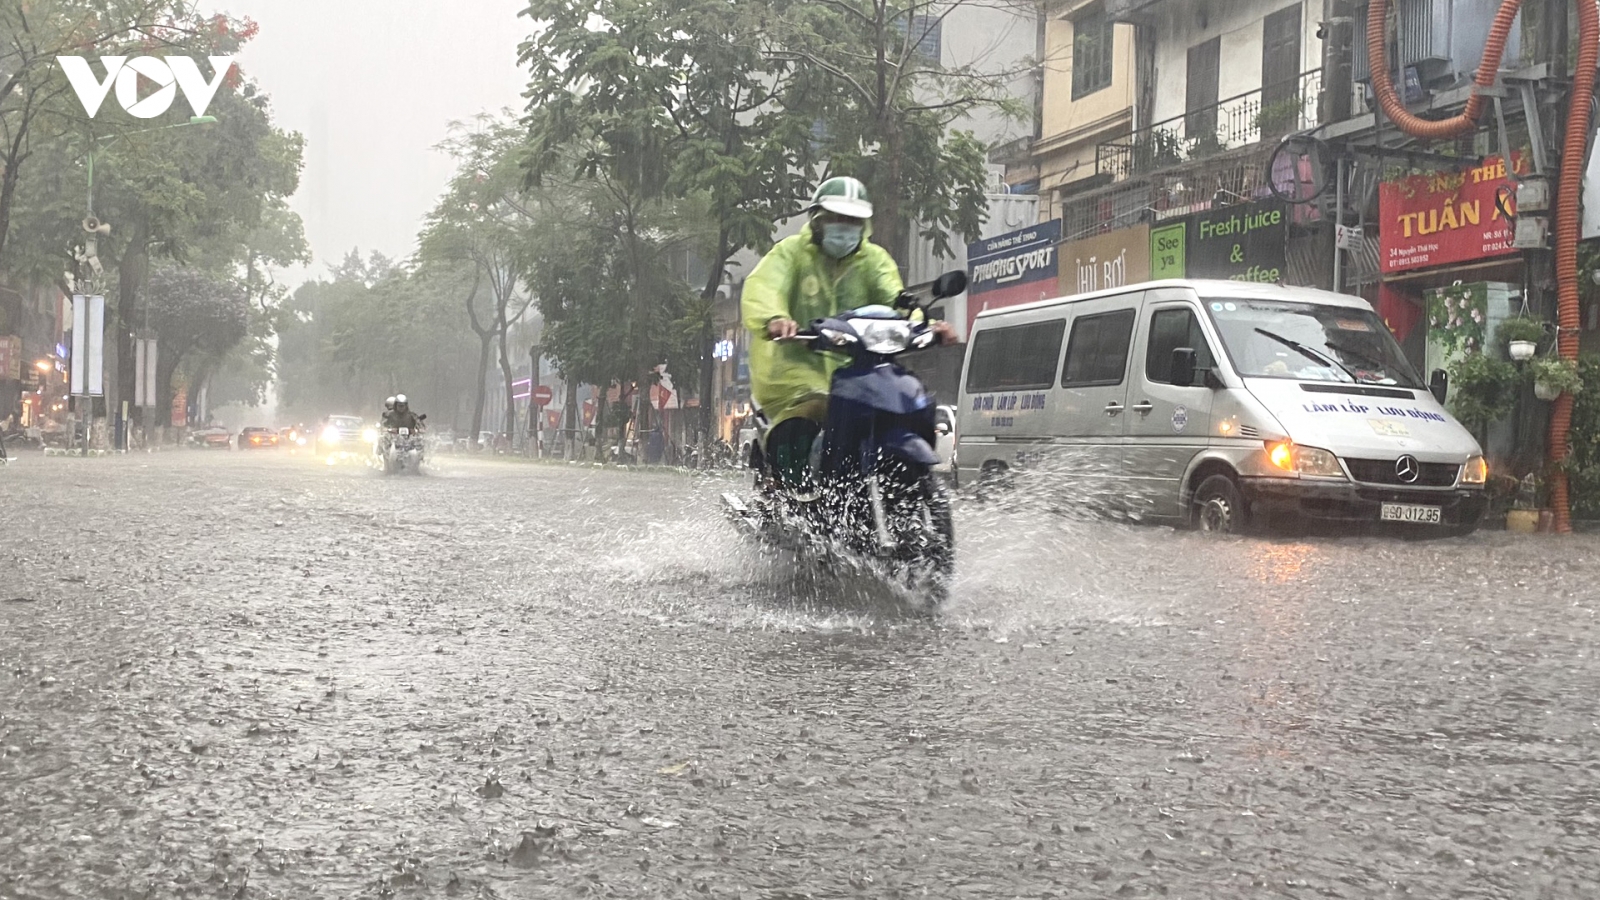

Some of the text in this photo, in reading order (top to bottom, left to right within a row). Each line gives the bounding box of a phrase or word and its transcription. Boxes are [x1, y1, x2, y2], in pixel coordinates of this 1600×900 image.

[1200, 209, 1280, 240] Fresh juice
[1398, 194, 1480, 238] TUẤN
[1157, 237, 1179, 252] See
[1229, 244, 1243, 263] &
[1390, 247, 1398, 257] 34
[1161, 254, 1175, 270] ya
[1302, 398, 1446, 423] LÀM LỐP LƯU ĐỘNG
